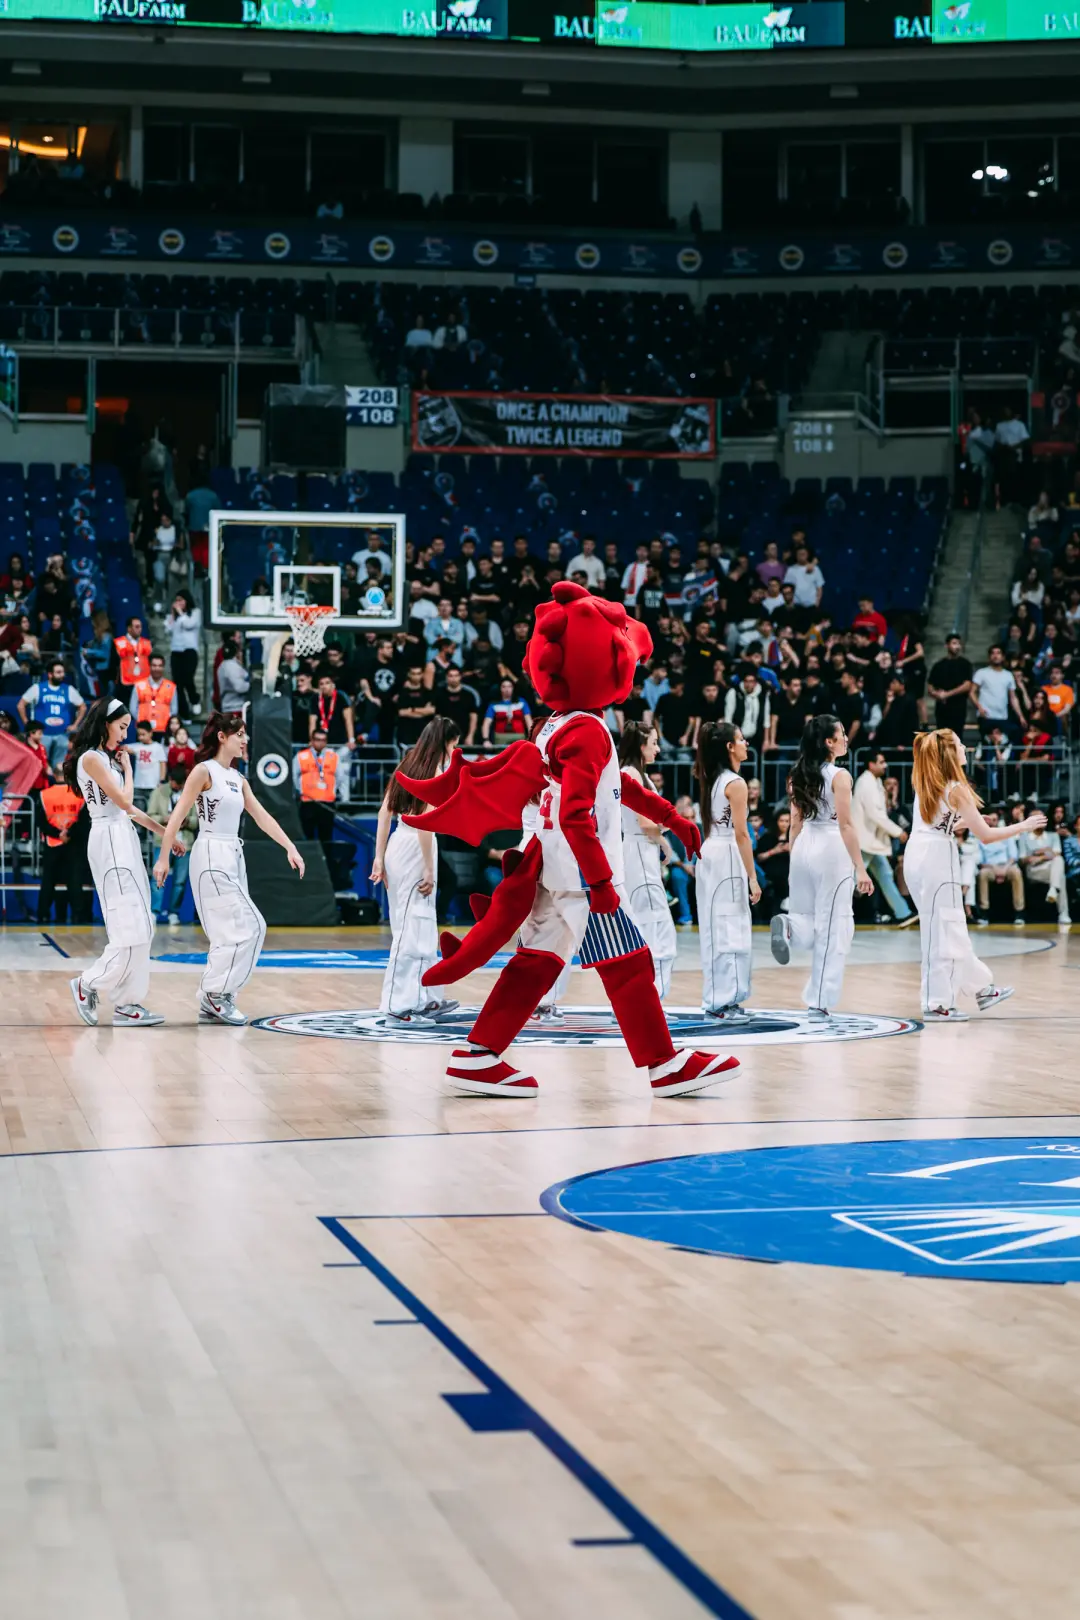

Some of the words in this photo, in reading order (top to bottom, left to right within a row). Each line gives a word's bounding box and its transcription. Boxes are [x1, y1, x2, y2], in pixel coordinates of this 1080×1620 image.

[358, 389, 394, 404] 208
[358, 408, 395, 424] 108
[496, 402, 536, 420] ONCE
[537, 403, 549, 421] A
[550, 403, 629, 423] CHAMPION
[506, 425, 552, 445] TWICE
[553, 427, 565, 446] A
[567, 427, 623, 447] LEGEND
